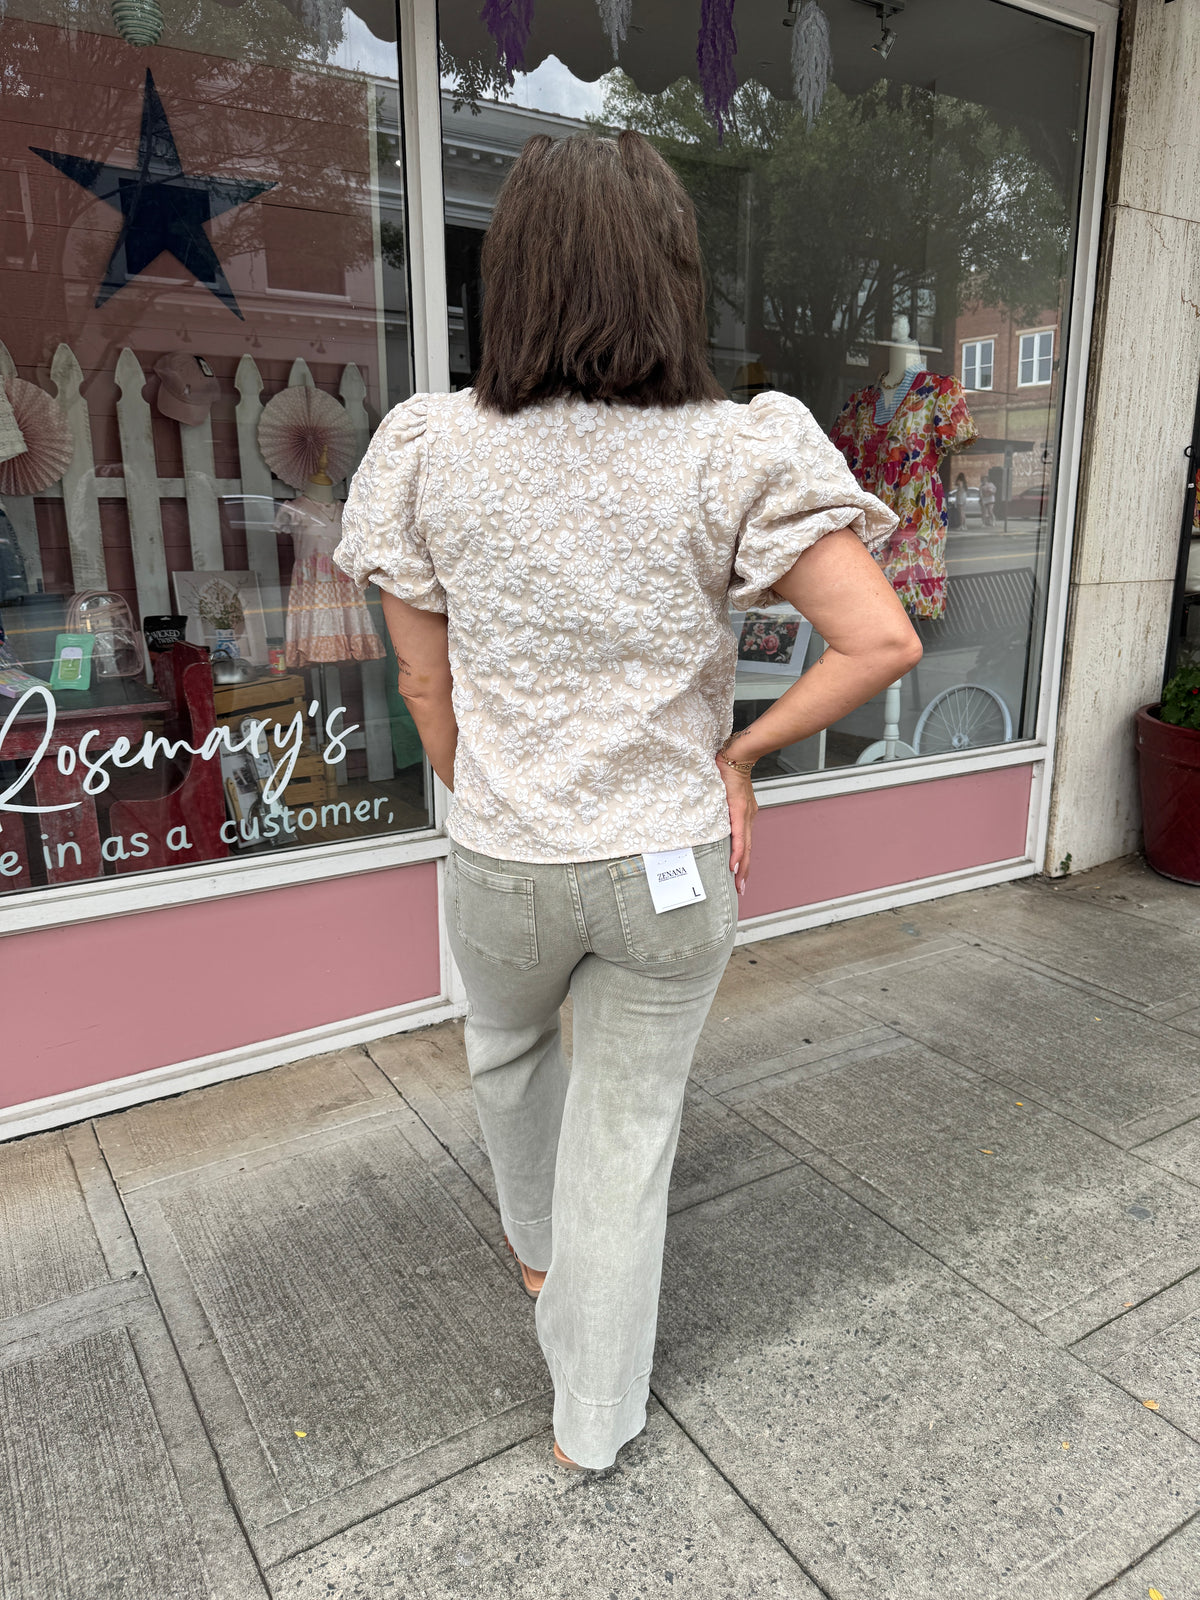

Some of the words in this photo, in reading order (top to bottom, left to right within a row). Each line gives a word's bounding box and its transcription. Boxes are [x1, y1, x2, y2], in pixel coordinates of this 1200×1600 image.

[151, 630, 180, 639] WICKED
[42, 834, 82, 870] in
[101, 832, 150, 862] as
[166, 826, 193, 851] a
[219, 797, 394, 844] customer,
[656, 866, 687, 881] ZENANA
[692, 886, 701, 897] L
